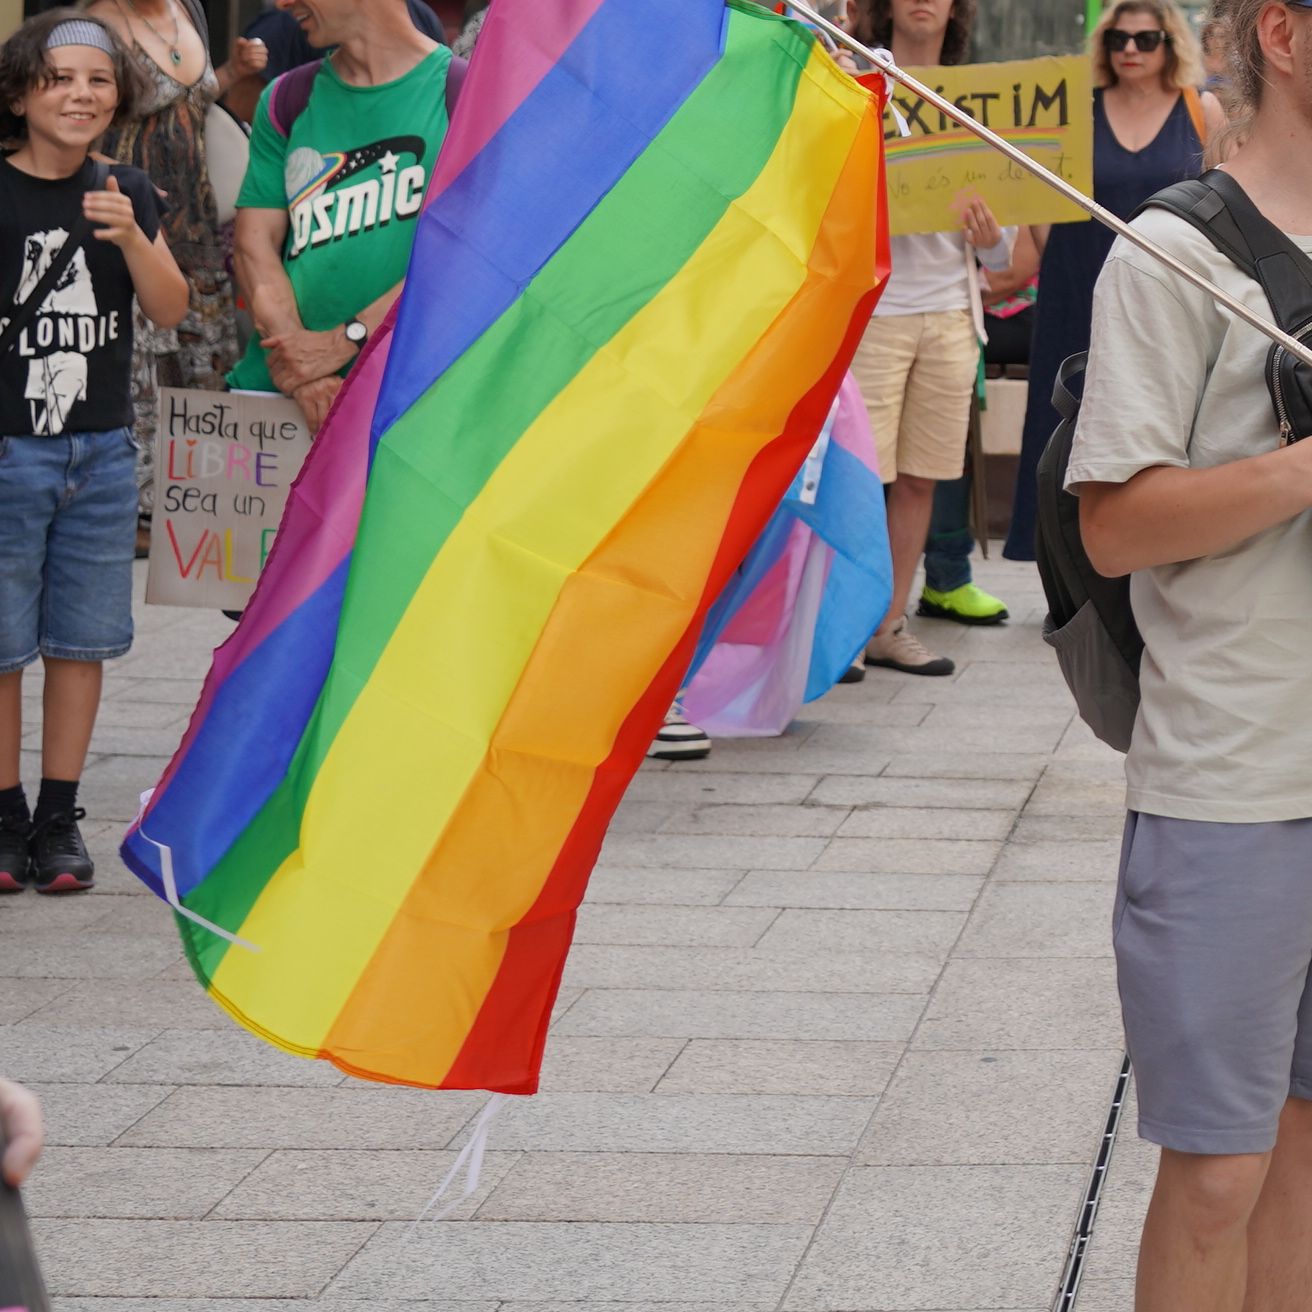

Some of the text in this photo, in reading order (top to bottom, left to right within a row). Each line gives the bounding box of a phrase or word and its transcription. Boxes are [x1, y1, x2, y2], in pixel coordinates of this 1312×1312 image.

[169, 395, 298, 450] Hasta que
[164, 485, 266, 517] sea un
